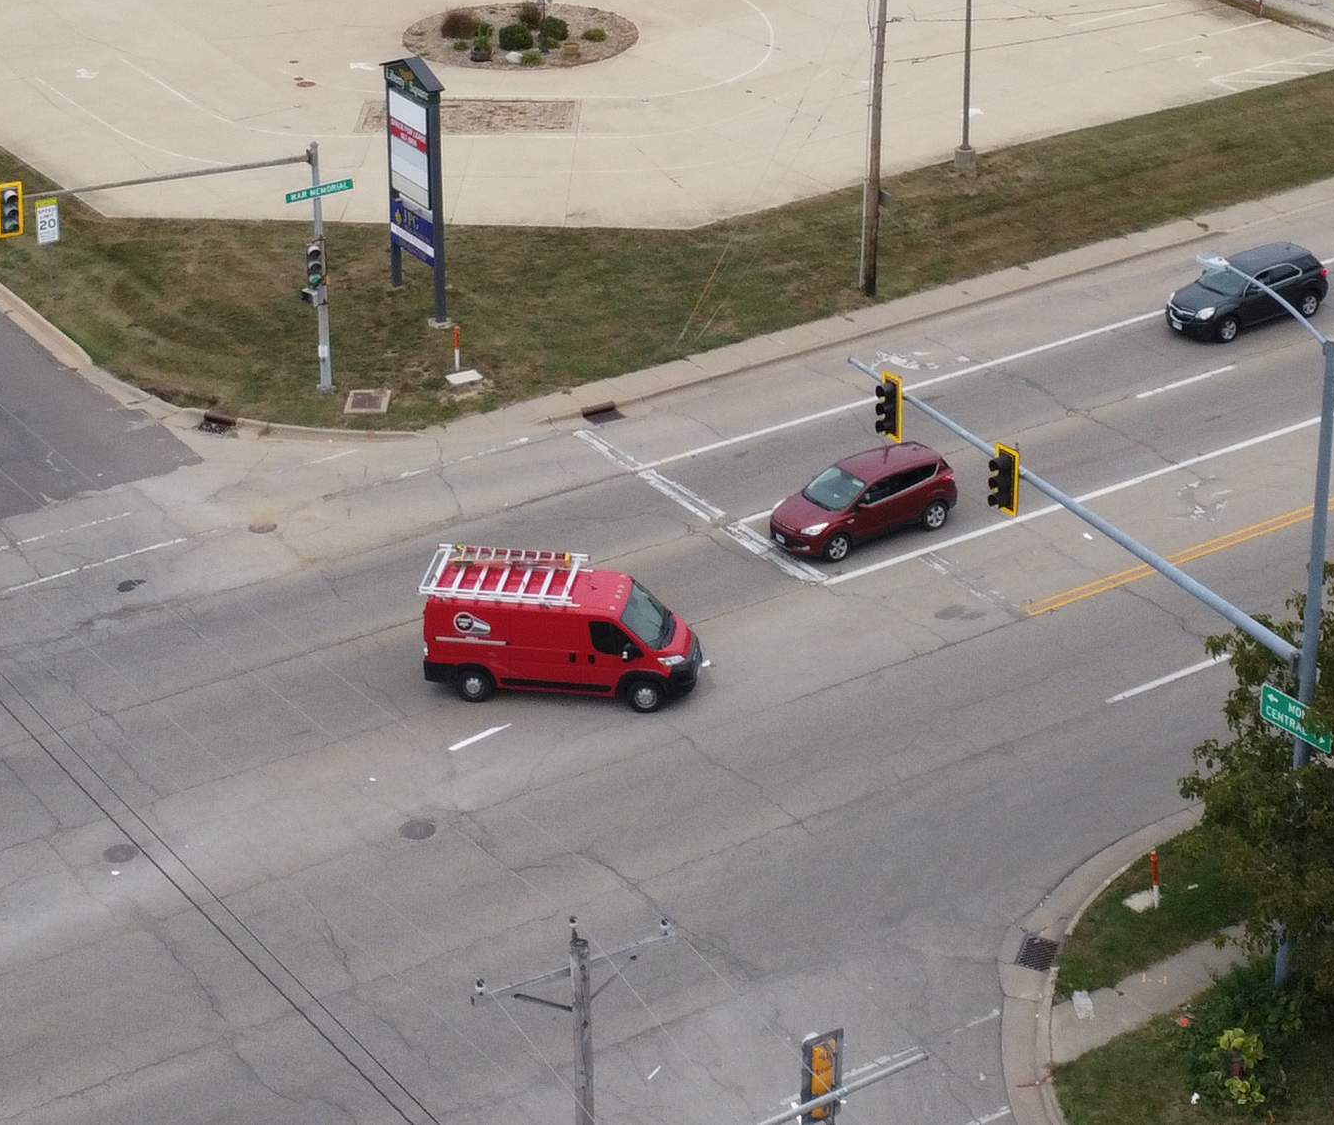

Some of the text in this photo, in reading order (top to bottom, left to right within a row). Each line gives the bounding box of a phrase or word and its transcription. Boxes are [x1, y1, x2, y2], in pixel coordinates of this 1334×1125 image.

[290, 182, 348, 201] WAR MEMORIAL
[40, 218, 56, 231] 20
[1266, 705, 1308, 736] CENTRAL
